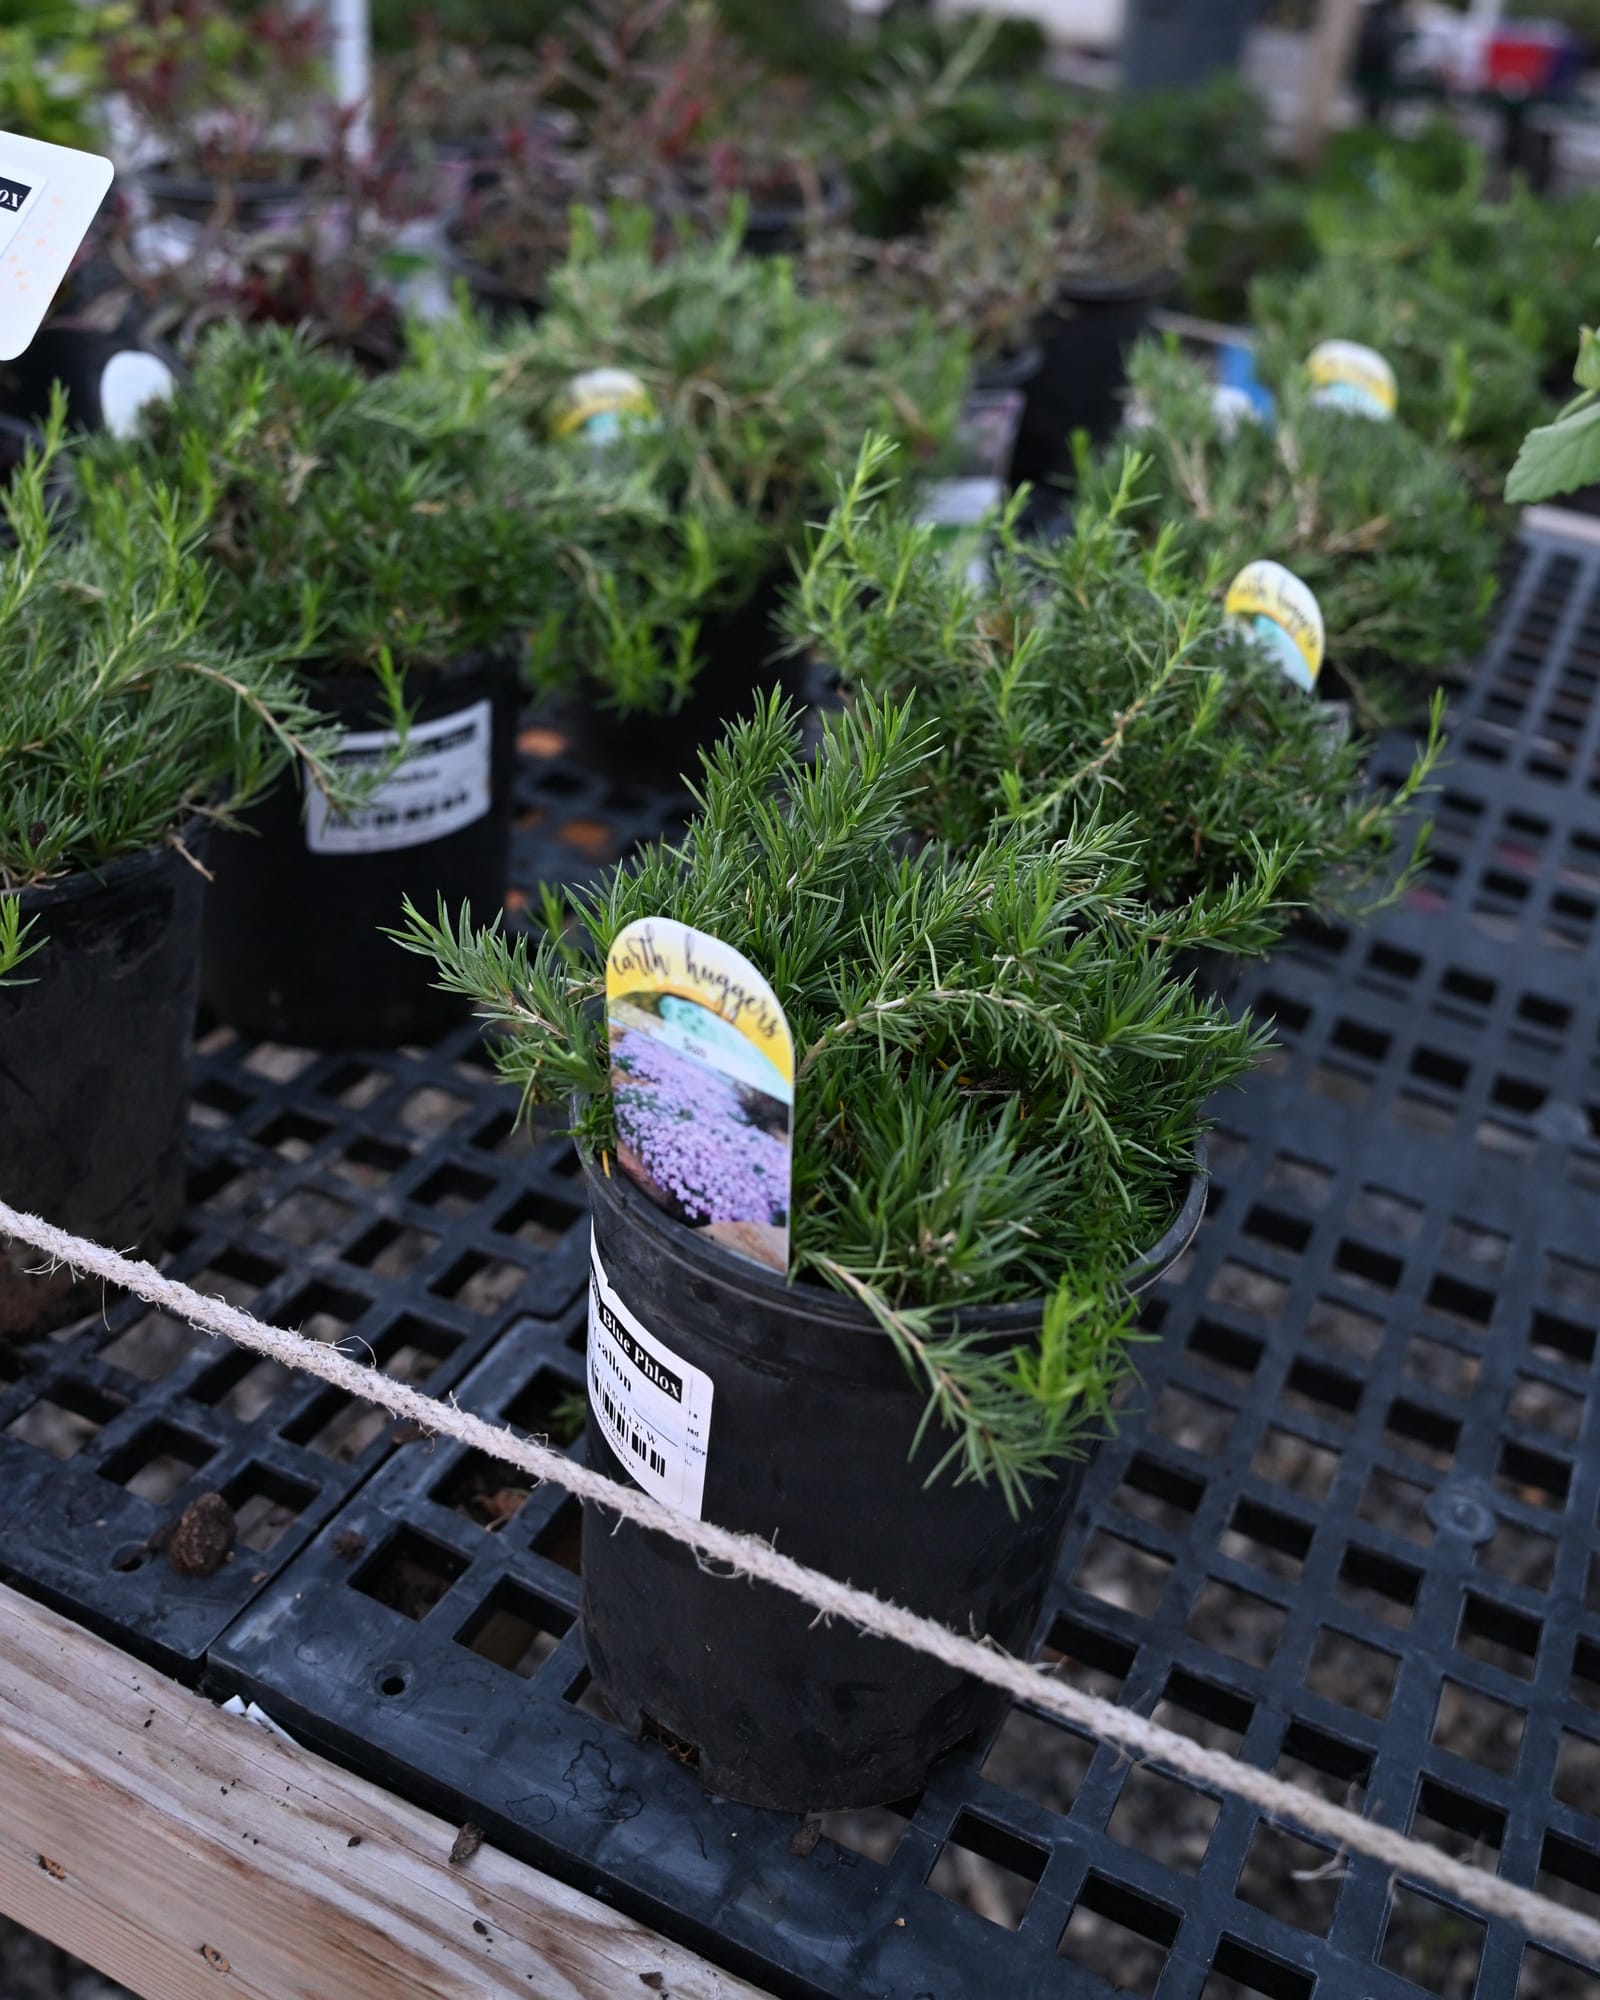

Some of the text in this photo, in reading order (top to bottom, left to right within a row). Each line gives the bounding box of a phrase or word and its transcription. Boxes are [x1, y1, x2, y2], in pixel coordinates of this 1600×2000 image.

[613, 924, 782, 1038] earth huggers
[594, 1325, 632, 1392] Gallon
[602, 1307, 680, 1399] Blue Phlox
